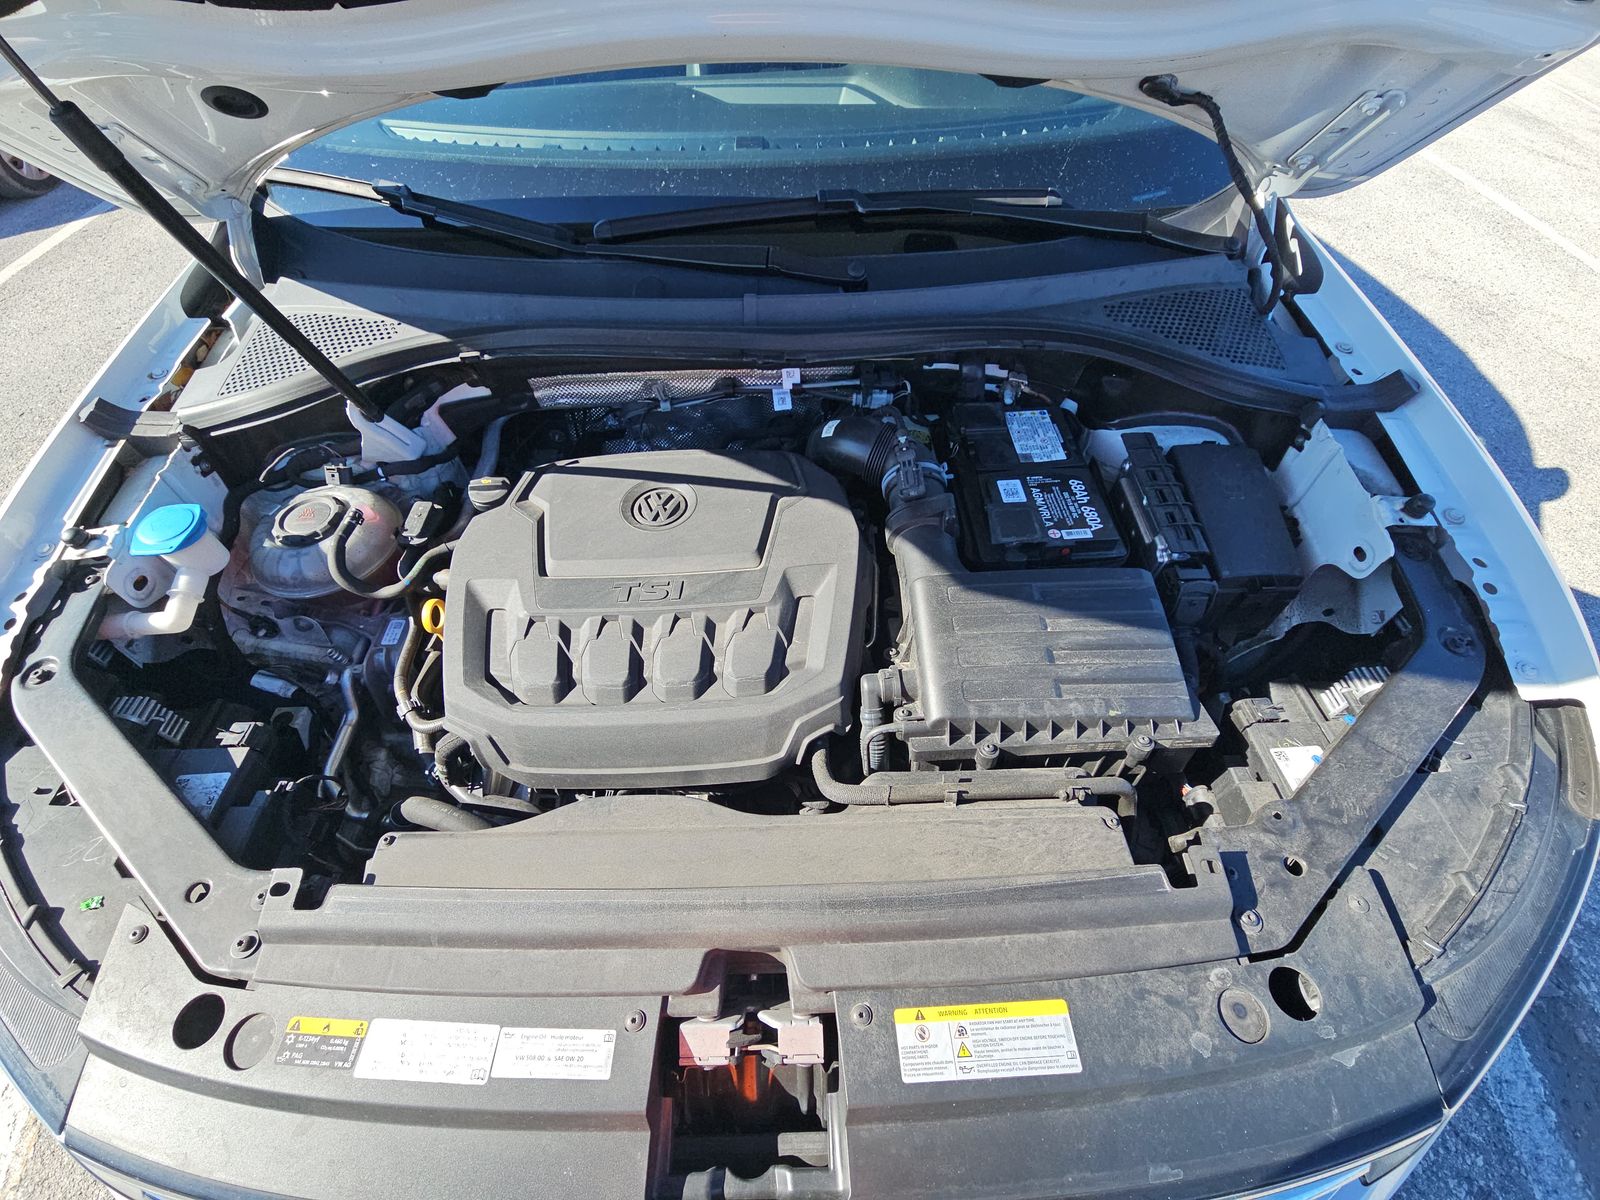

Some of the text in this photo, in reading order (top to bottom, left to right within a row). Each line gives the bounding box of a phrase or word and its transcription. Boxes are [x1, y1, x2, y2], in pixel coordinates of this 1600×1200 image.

[634, 489, 687, 524] VW
[1069, 480, 1090, 503] 68Ah
[1081, 506, 1103, 531] 680A
[614, 580, 684, 602] TSI
[938, 1007, 1008, 1017] WARNING ATTENTION
